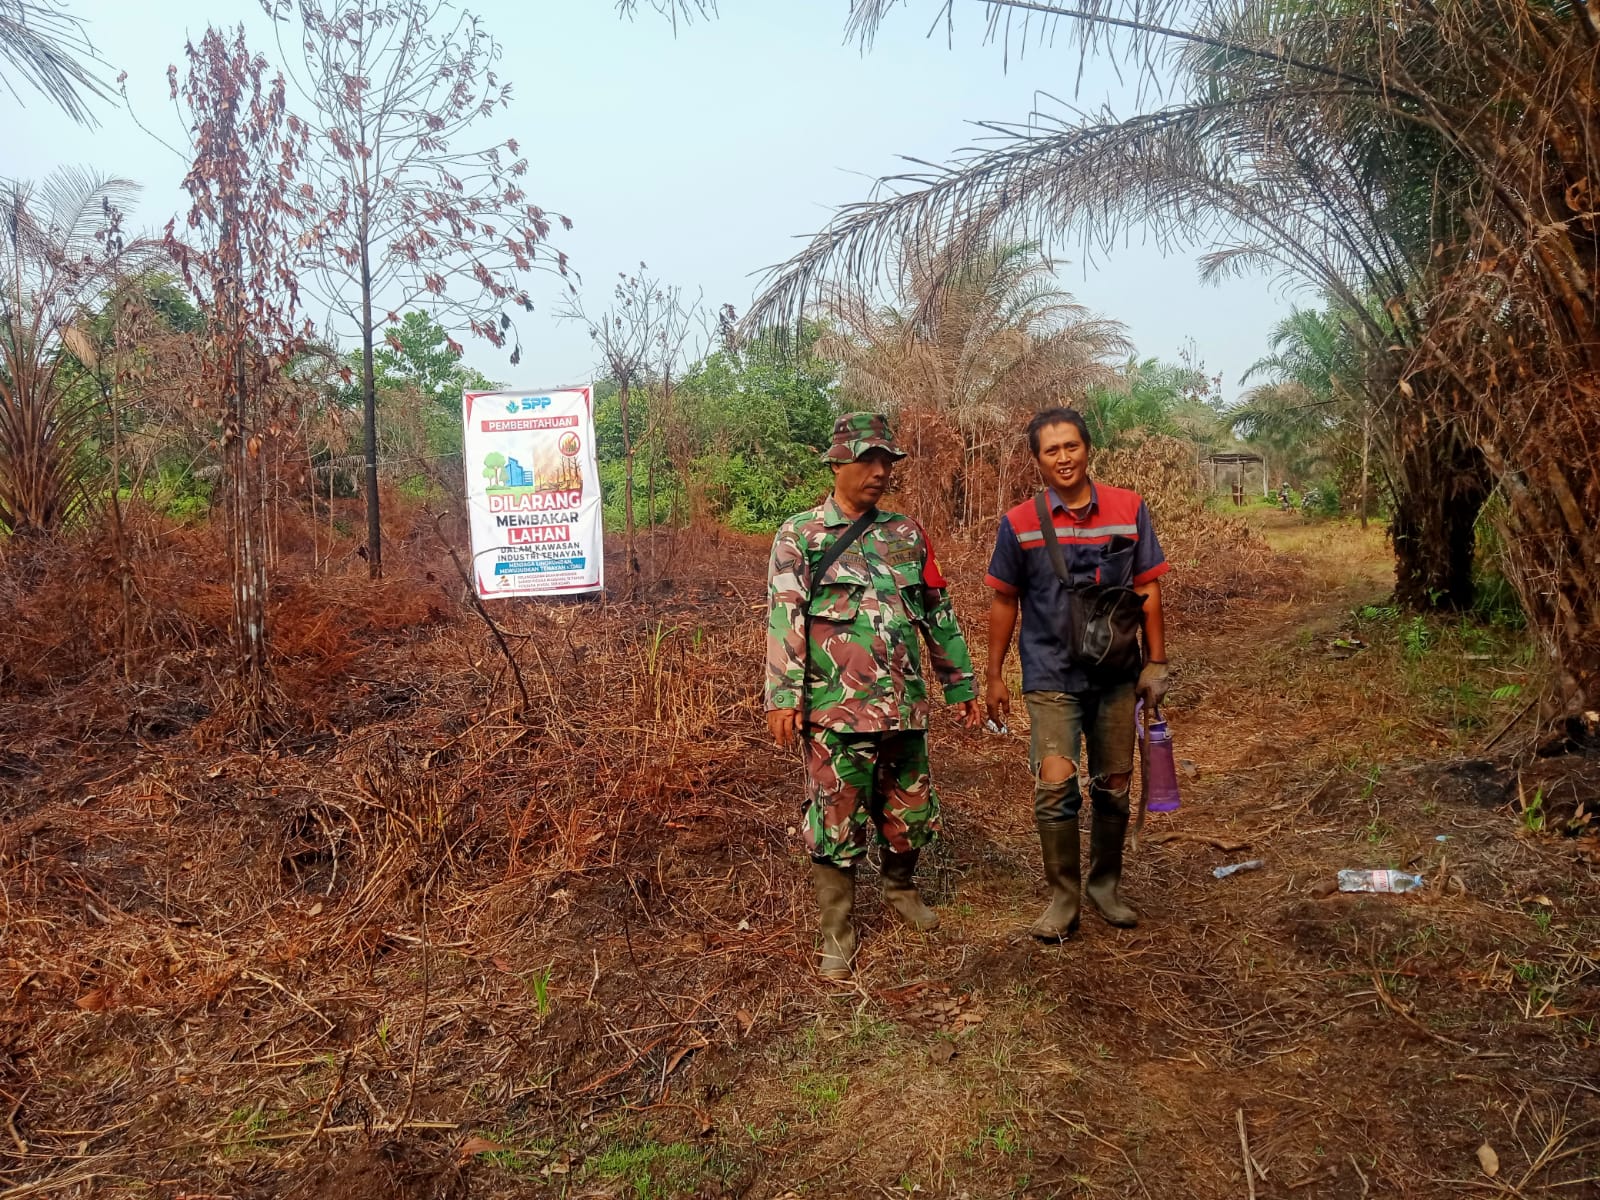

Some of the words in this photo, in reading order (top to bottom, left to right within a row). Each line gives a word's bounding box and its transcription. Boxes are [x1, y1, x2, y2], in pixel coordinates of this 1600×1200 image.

[521, 397, 552, 410] SPP
[488, 417, 573, 431] PEMBERITAHUAN
[490, 491, 582, 512] DILARANG
[496, 511, 579, 527] MEMBAKAR
[510, 526, 567, 543] LAHAN
[500, 545, 532, 554] DALAM
[535, 542, 580, 552] KAWASAN
[497, 552, 540, 562] INDUSTRI
[541, 550, 584, 560] TENAYAN
